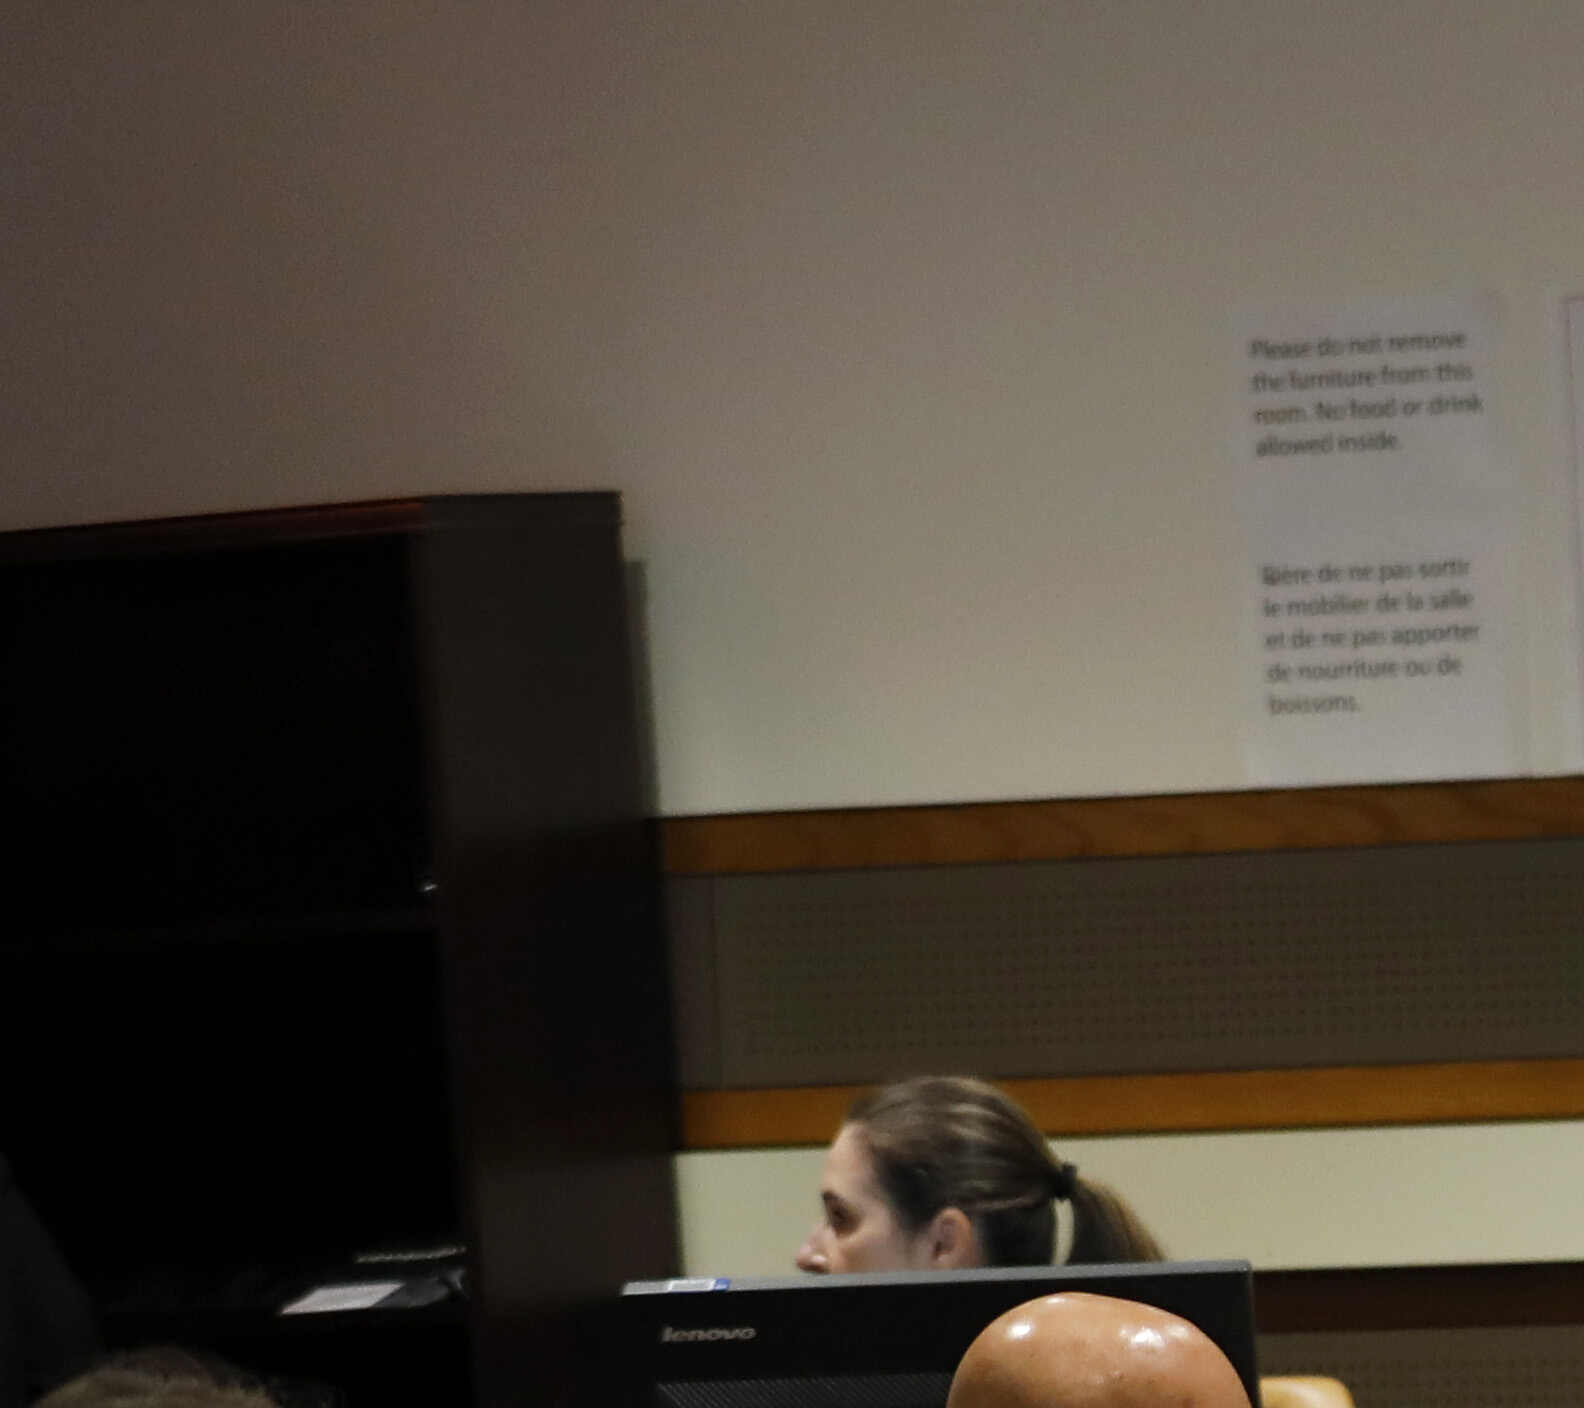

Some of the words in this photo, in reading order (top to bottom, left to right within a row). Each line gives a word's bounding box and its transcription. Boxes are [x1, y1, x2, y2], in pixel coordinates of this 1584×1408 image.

[1250, 339, 1311, 359] Please
[1317, 337, 1338, 357] do
[1350, 336, 1382, 355] not
[1388, 332, 1468, 352] remove
[1252, 371, 1283, 391] the
[1288, 368, 1376, 390] furniture
[1380, 364, 1430, 386] from
[1434, 361, 1474, 384] this
[1349, 398, 1399, 420] food
[1402, 401, 1422, 417] or
[1428, 393, 1485, 417] drink
[1256, 433, 1334, 457] allowed
[661, 1326, 757, 1343] lenovo
